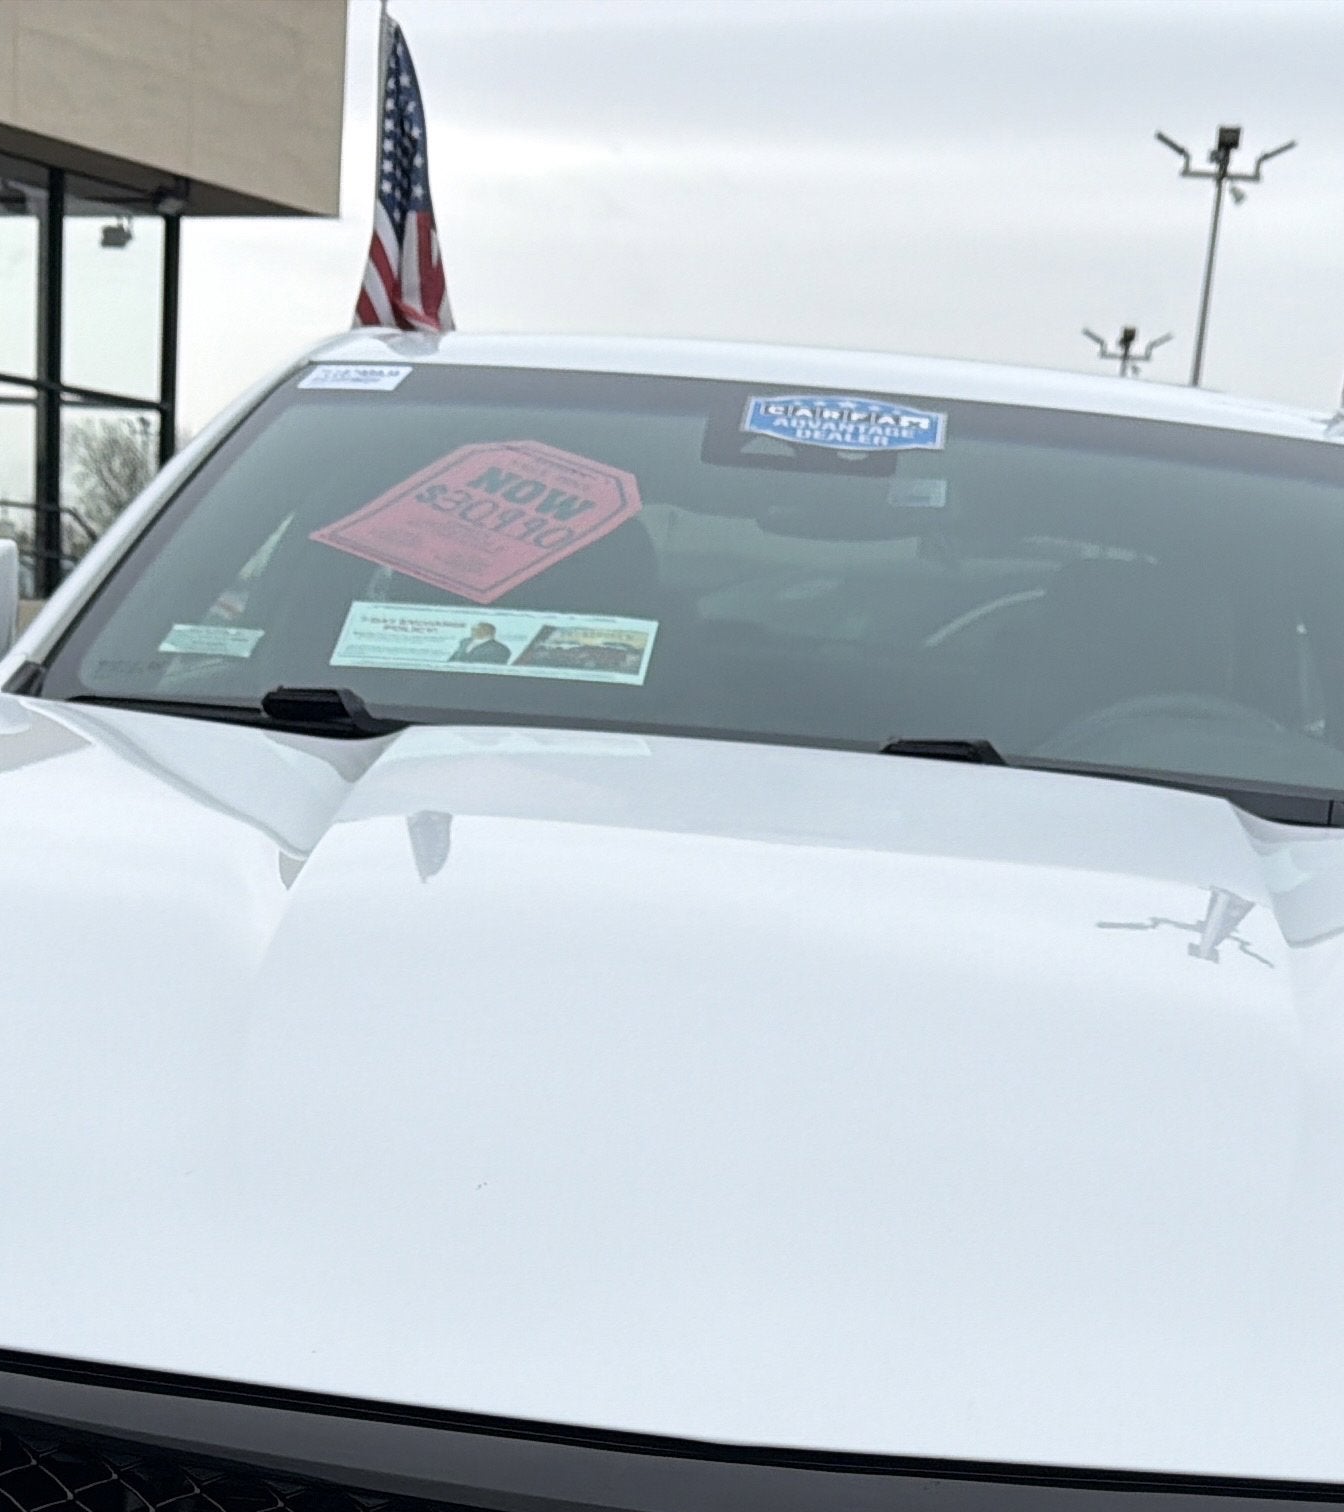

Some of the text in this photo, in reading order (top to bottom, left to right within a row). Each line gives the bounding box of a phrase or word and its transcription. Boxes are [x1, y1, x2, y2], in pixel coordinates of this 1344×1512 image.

[773, 417, 914, 438] ADVANTAGE
[795, 429, 889, 447] DEALER
[467, 466, 596, 521] NOW
